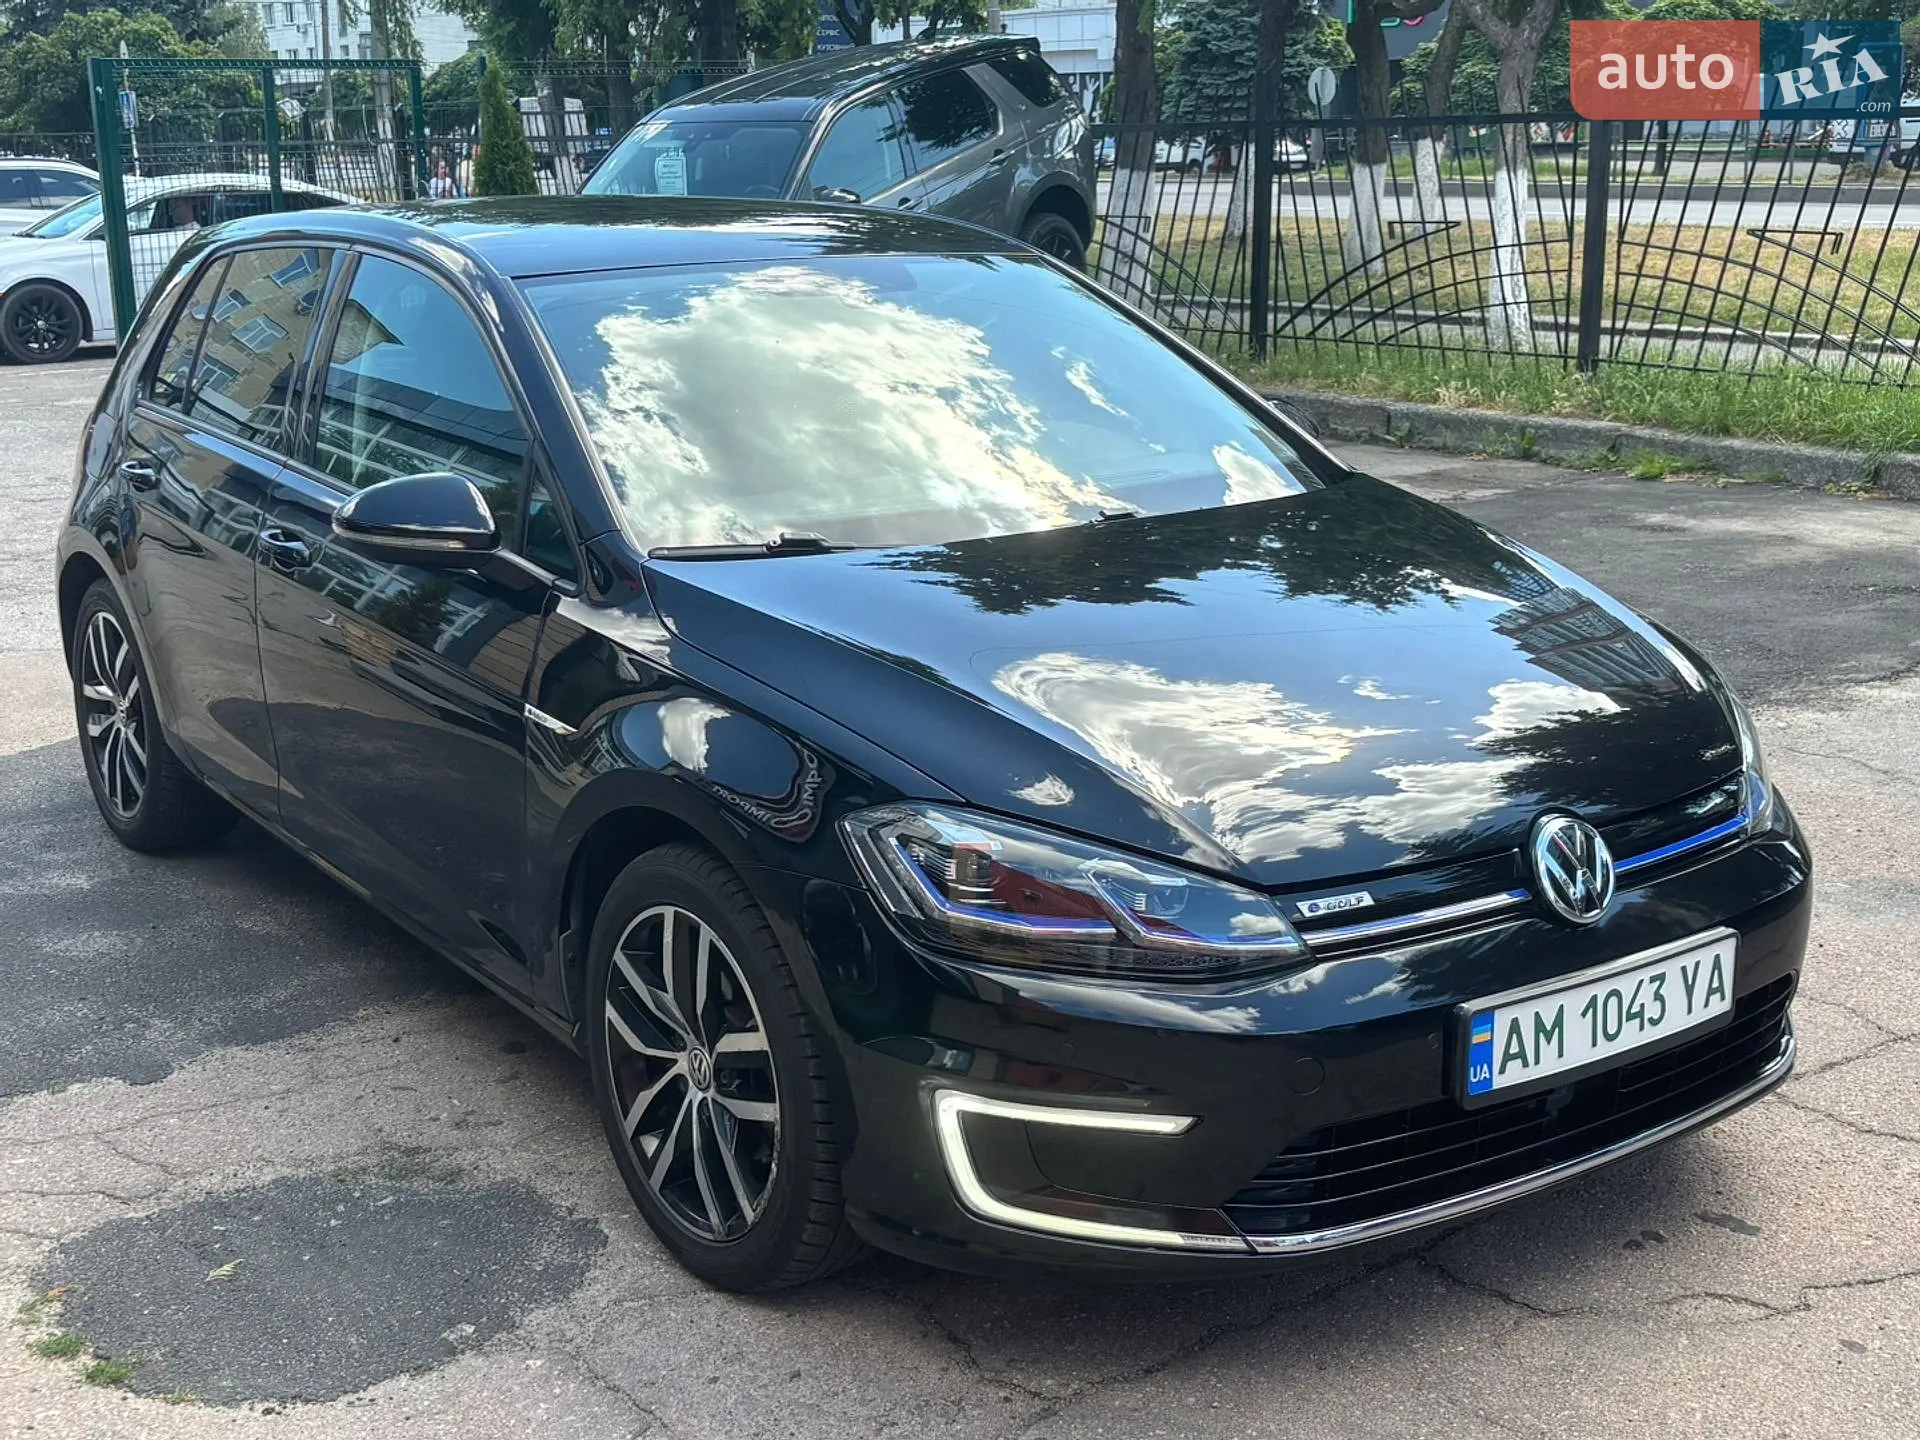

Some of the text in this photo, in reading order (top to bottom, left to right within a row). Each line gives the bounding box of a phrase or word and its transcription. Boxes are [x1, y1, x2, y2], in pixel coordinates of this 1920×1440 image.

[1498, 953, 1726, 1075] AM 1043 YA
[1470, 1063, 1490, 1082] UA
